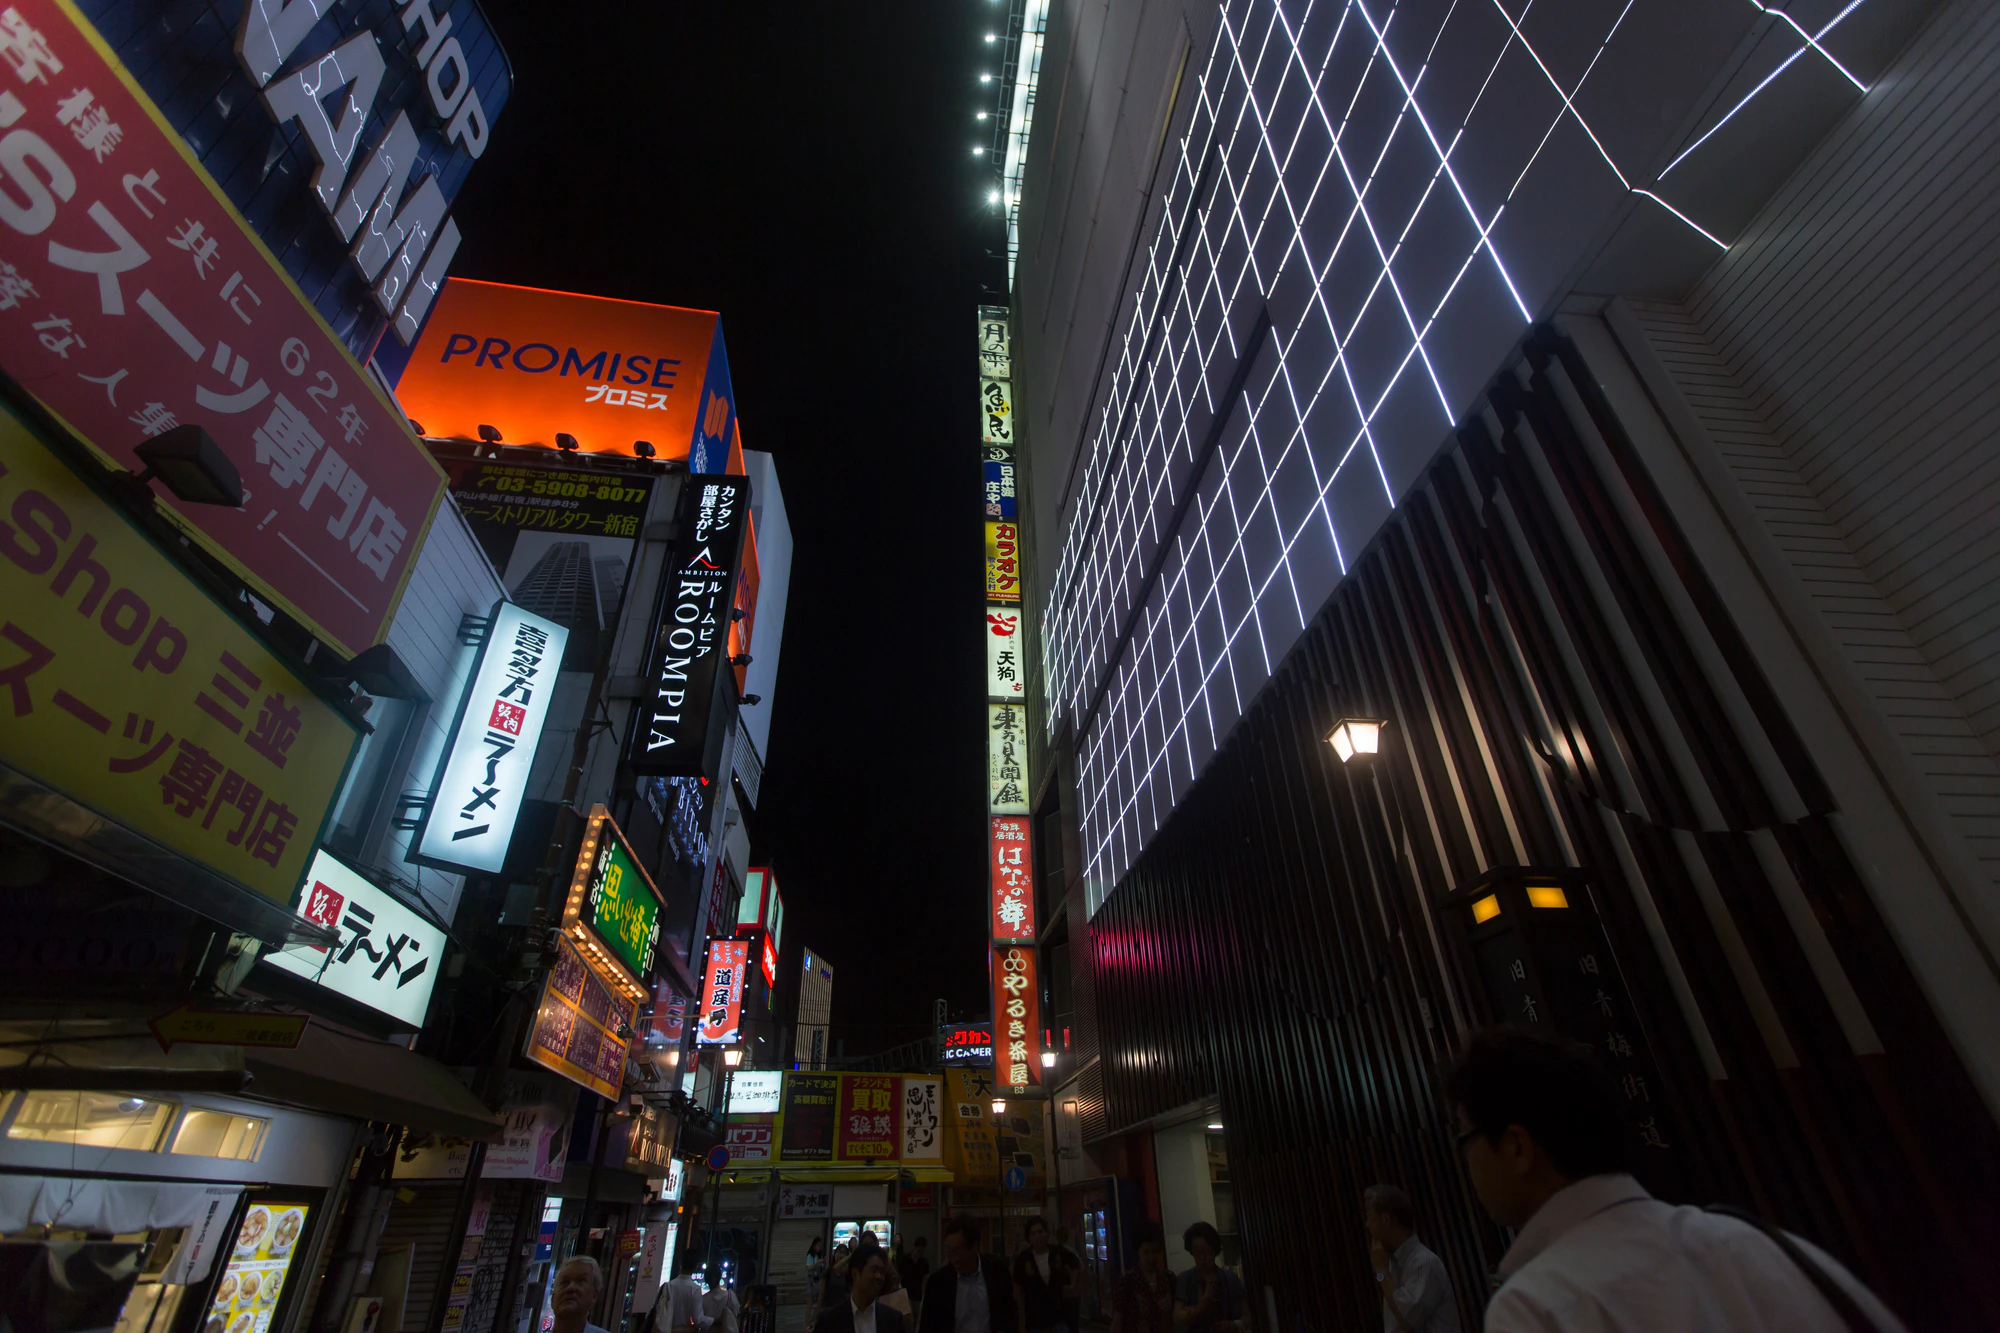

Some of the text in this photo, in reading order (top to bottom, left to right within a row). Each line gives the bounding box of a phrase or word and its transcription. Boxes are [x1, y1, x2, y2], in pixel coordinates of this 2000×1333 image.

[440, 333, 683, 390] PROMISE
[48, 200, 408, 582] スーツ専門店
[585, 384, 669, 410] プロミス
[494, 475, 648, 504] 03-5908-8077
[985, 481, 1001, 504] 庄や
[1000, 465, 1016, 498] 日本海
[456, 502, 640, 538] ァーストリアルタワー新宿
[696, 484, 720, 543] 部屋さがし
[715, 484, 736, 531] カンタン
[677, 569, 728, 578] AMBITION
[995, 523, 1019, 591] カラオケ
[696, 580, 722, 659] ルームピア
[498, 621, 549, 707] 喜多方
[646, 579, 706, 753] ROOMPIA
[997, 650, 1016, 682] 天狗
[194, 649, 304, 771] 三並
[0, 620, 300, 870] スーツ専門店
[995, 832, 1026, 842] 居酒屋
[999, 822, 1020, 832] 海鮮
[996, 846, 1028, 932] はなの舞
[1010, 937, 1017, 945] 5
[1002, 972, 1029, 1086] やるき茶屋
[1577, 953, 1671, 1151] 旧青梅街道
[852, 1077, 892, 1089] ブランド品
[1013, 1085, 1025, 1095] B3
[850, 1088, 892, 1113] 買取
[960, 1104, 981, 1117] 金券
[447, 1150, 467, 1165] Bag
